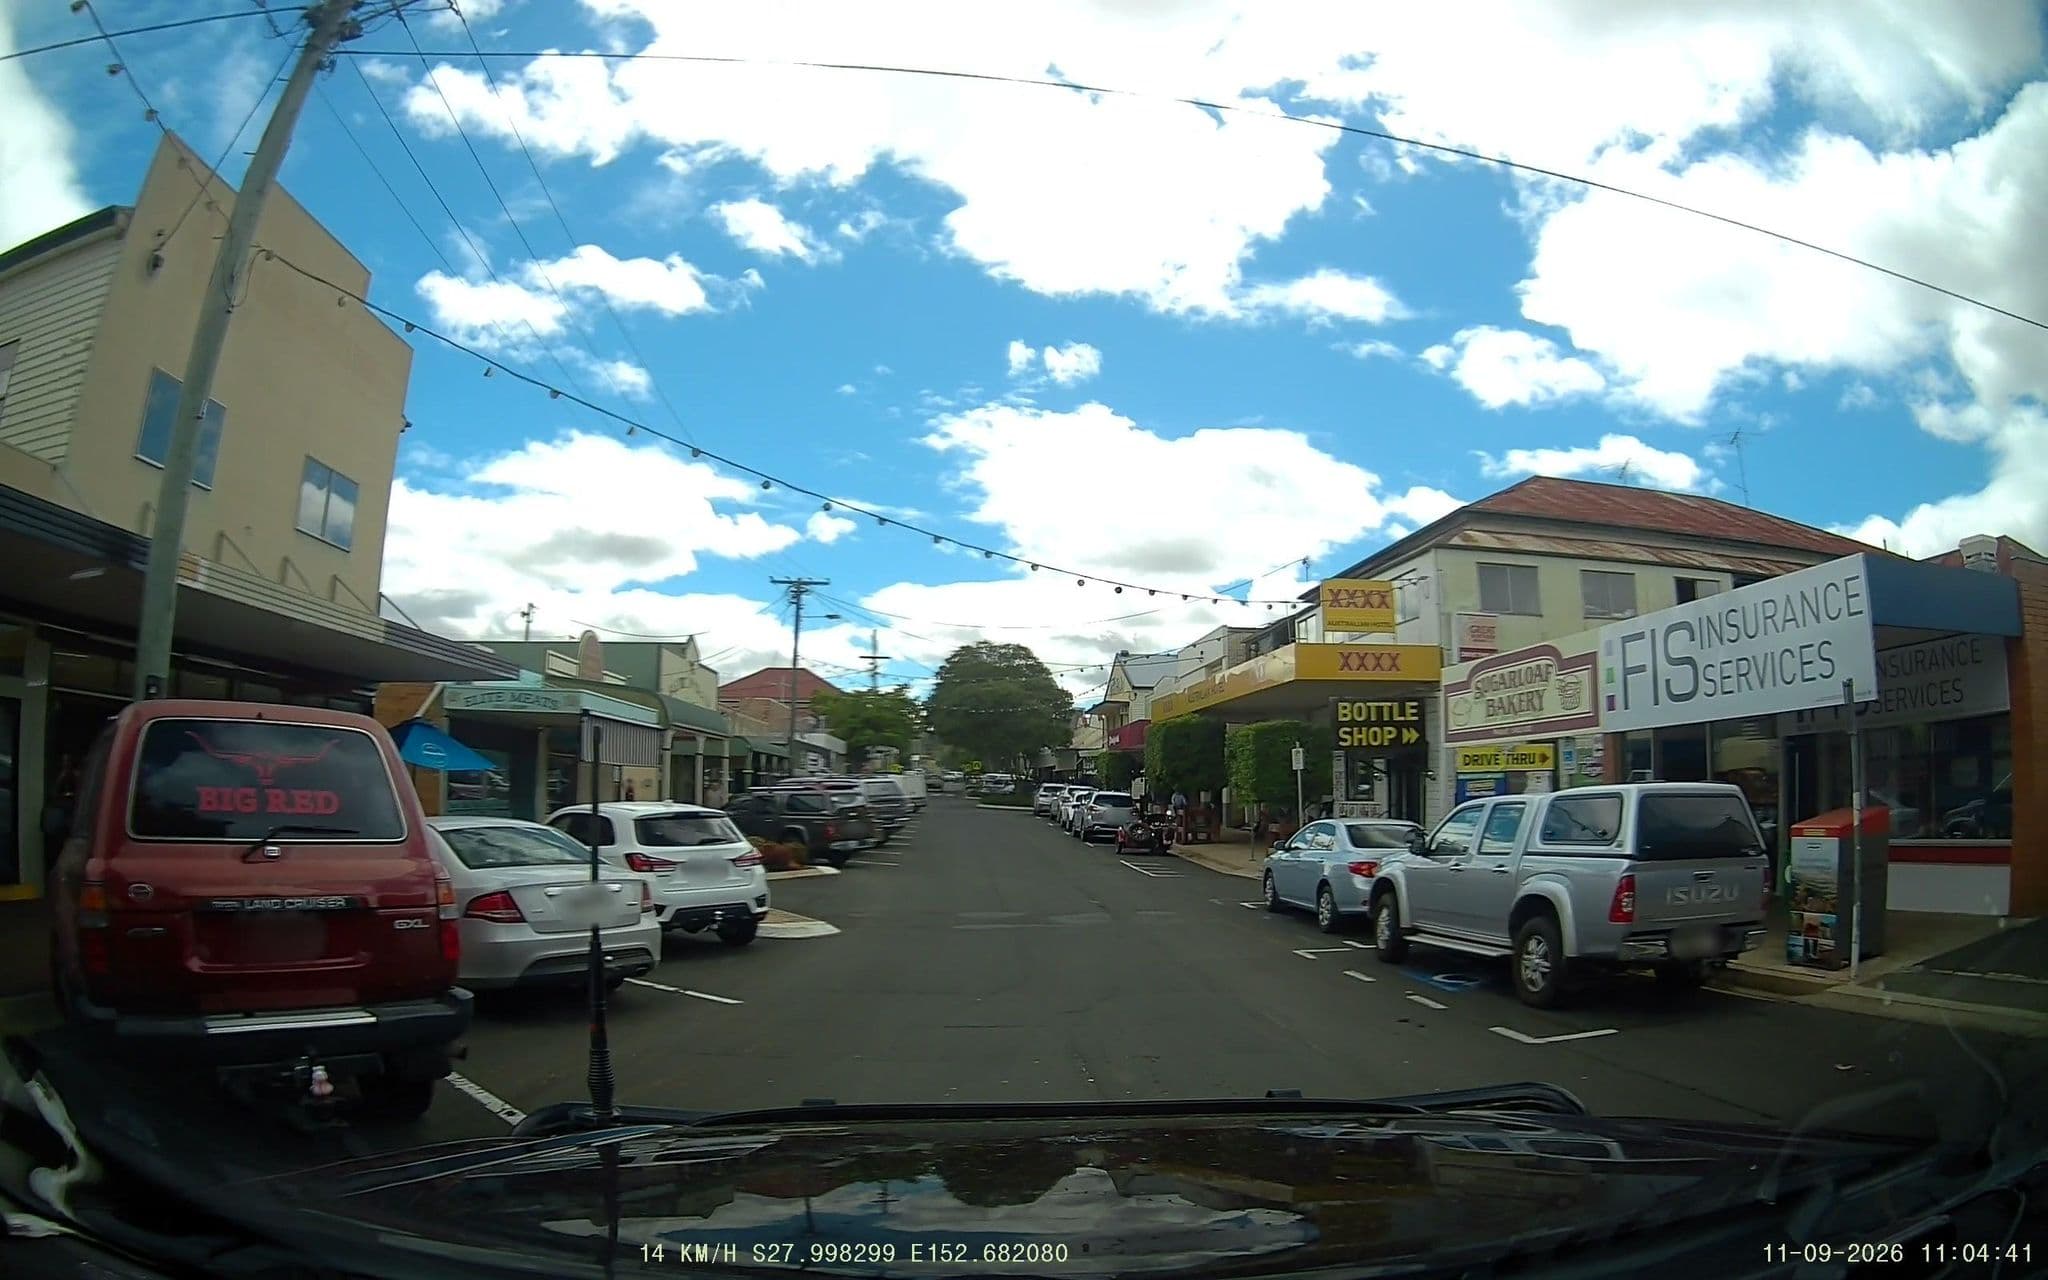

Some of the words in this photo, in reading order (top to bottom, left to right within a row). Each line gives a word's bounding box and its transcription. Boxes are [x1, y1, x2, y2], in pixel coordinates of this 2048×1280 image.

[1327, 588, 1391, 608] XXXX
[1698, 574, 1864, 651] INSURANCE
[1338, 652, 1401, 671] XXXX
[1621, 620, 1699, 711] FIS
[1877, 637, 1984, 680] NSURANCE
[1702, 640, 1836, 698] SERVICES
[1474, 664, 1554, 700] SUGARLOAF
[463, 691, 505, 707] ELITE
[508, 692, 561, 710] MEATS
[1486, 688, 1548, 717] BAKERY
[1337, 702, 1419, 722] BOTTLE
[1338, 727, 1398, 747] SHOP
[1463, 753, 1500, 766] DRIVE
[1504, 752, 1536, 765] THRU
[198, 787, 257, 813] BIG
[265, 788, 341, 815] RED
[243, 899, 281, 910] LAND
[284, 897, 347, 909] CRUISER
[1666, 884, 1739, 905] ISUZU
[393, 919, 431, 929] GXL
